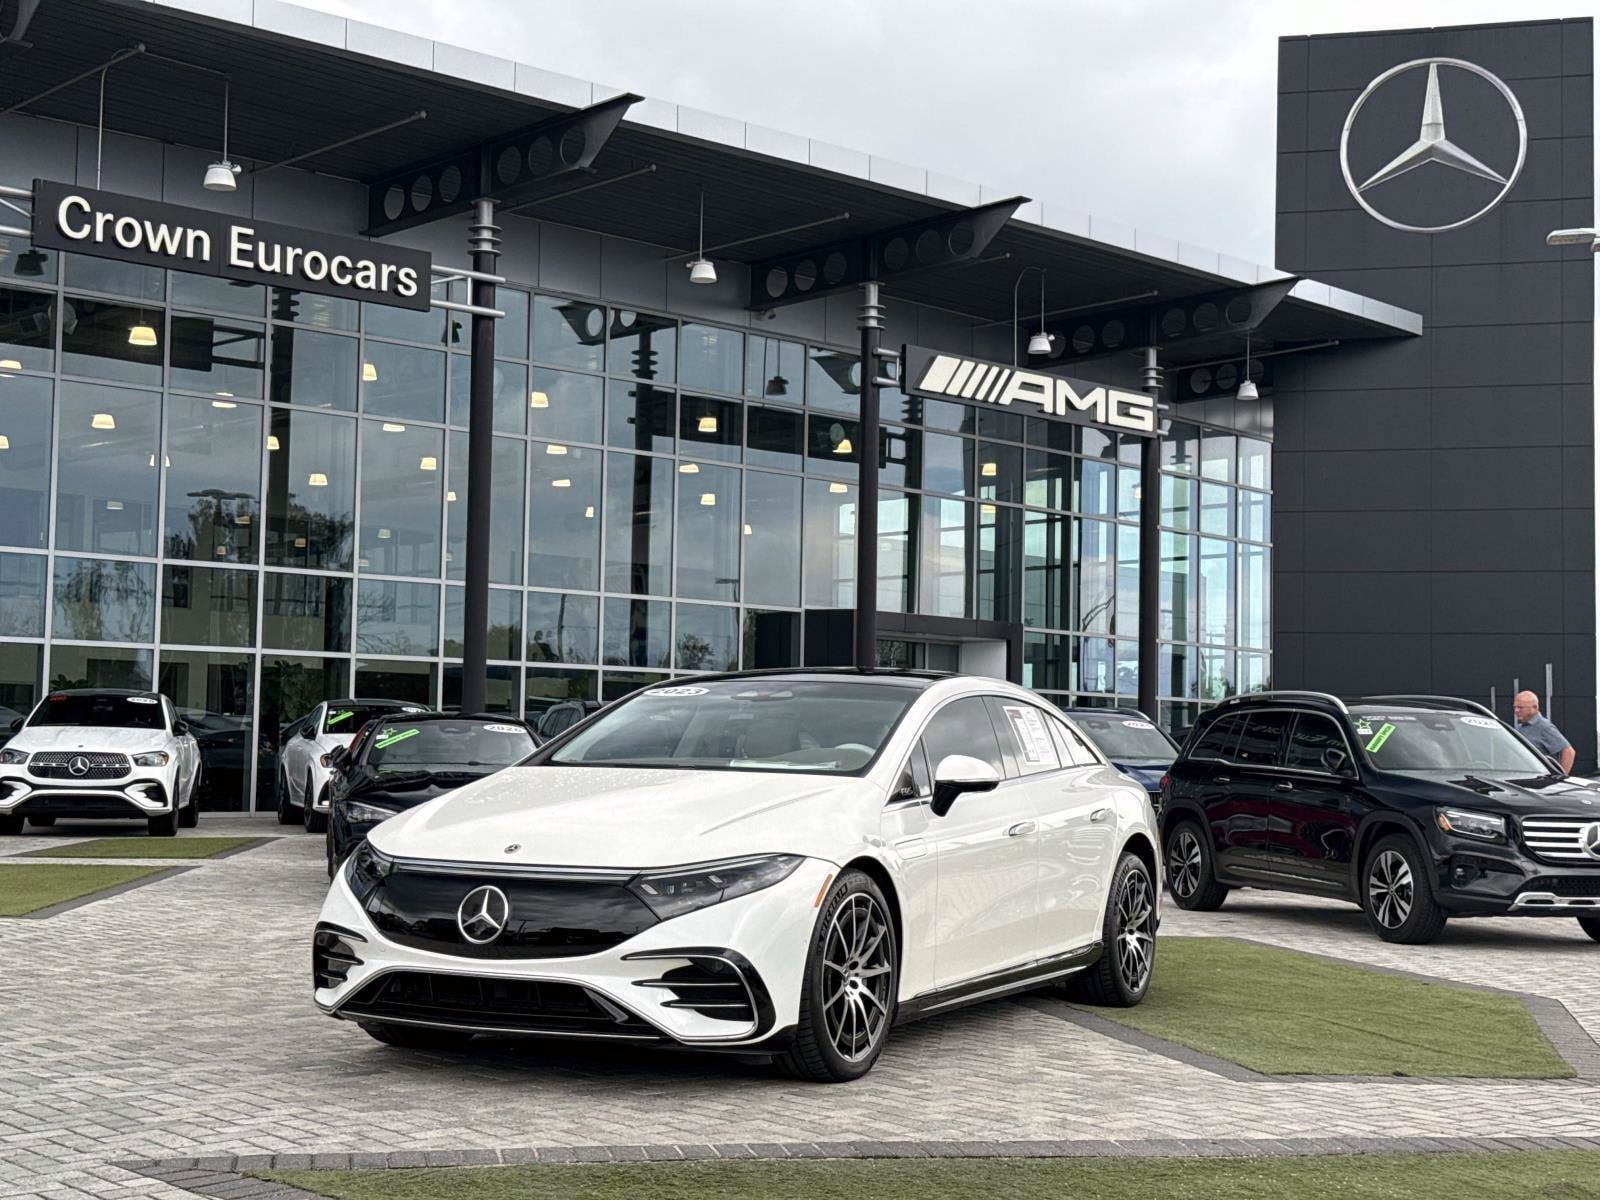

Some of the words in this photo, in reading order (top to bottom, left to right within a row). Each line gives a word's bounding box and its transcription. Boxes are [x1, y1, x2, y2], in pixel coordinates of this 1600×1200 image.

[57, 195, 211, 262] Crown
[229, 225, 419, 297] Eurocars
[997, 370, 1154, 432] AMG
